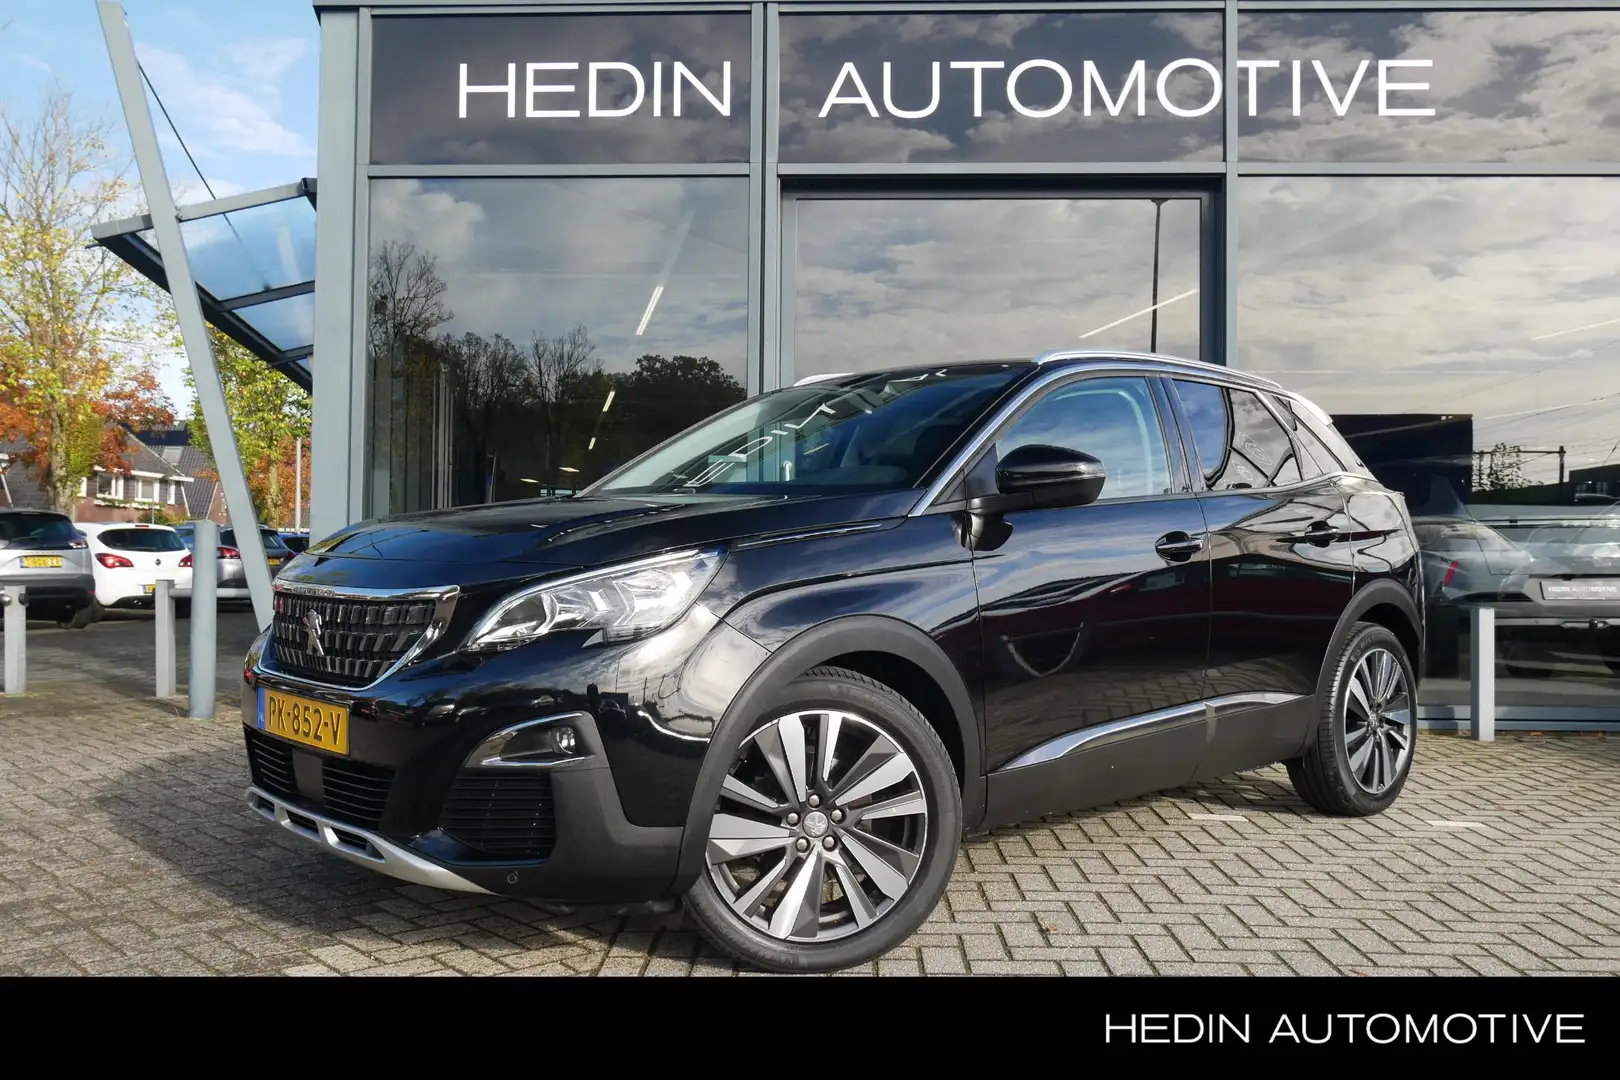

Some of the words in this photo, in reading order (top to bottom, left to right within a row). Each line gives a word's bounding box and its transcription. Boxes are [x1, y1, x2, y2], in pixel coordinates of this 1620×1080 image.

[457, 61, 732, 119] HEDIN
[818, 58, 1437, 119] AUTOMOTIVE
[269, 695, 341, 746] PK-852-V
